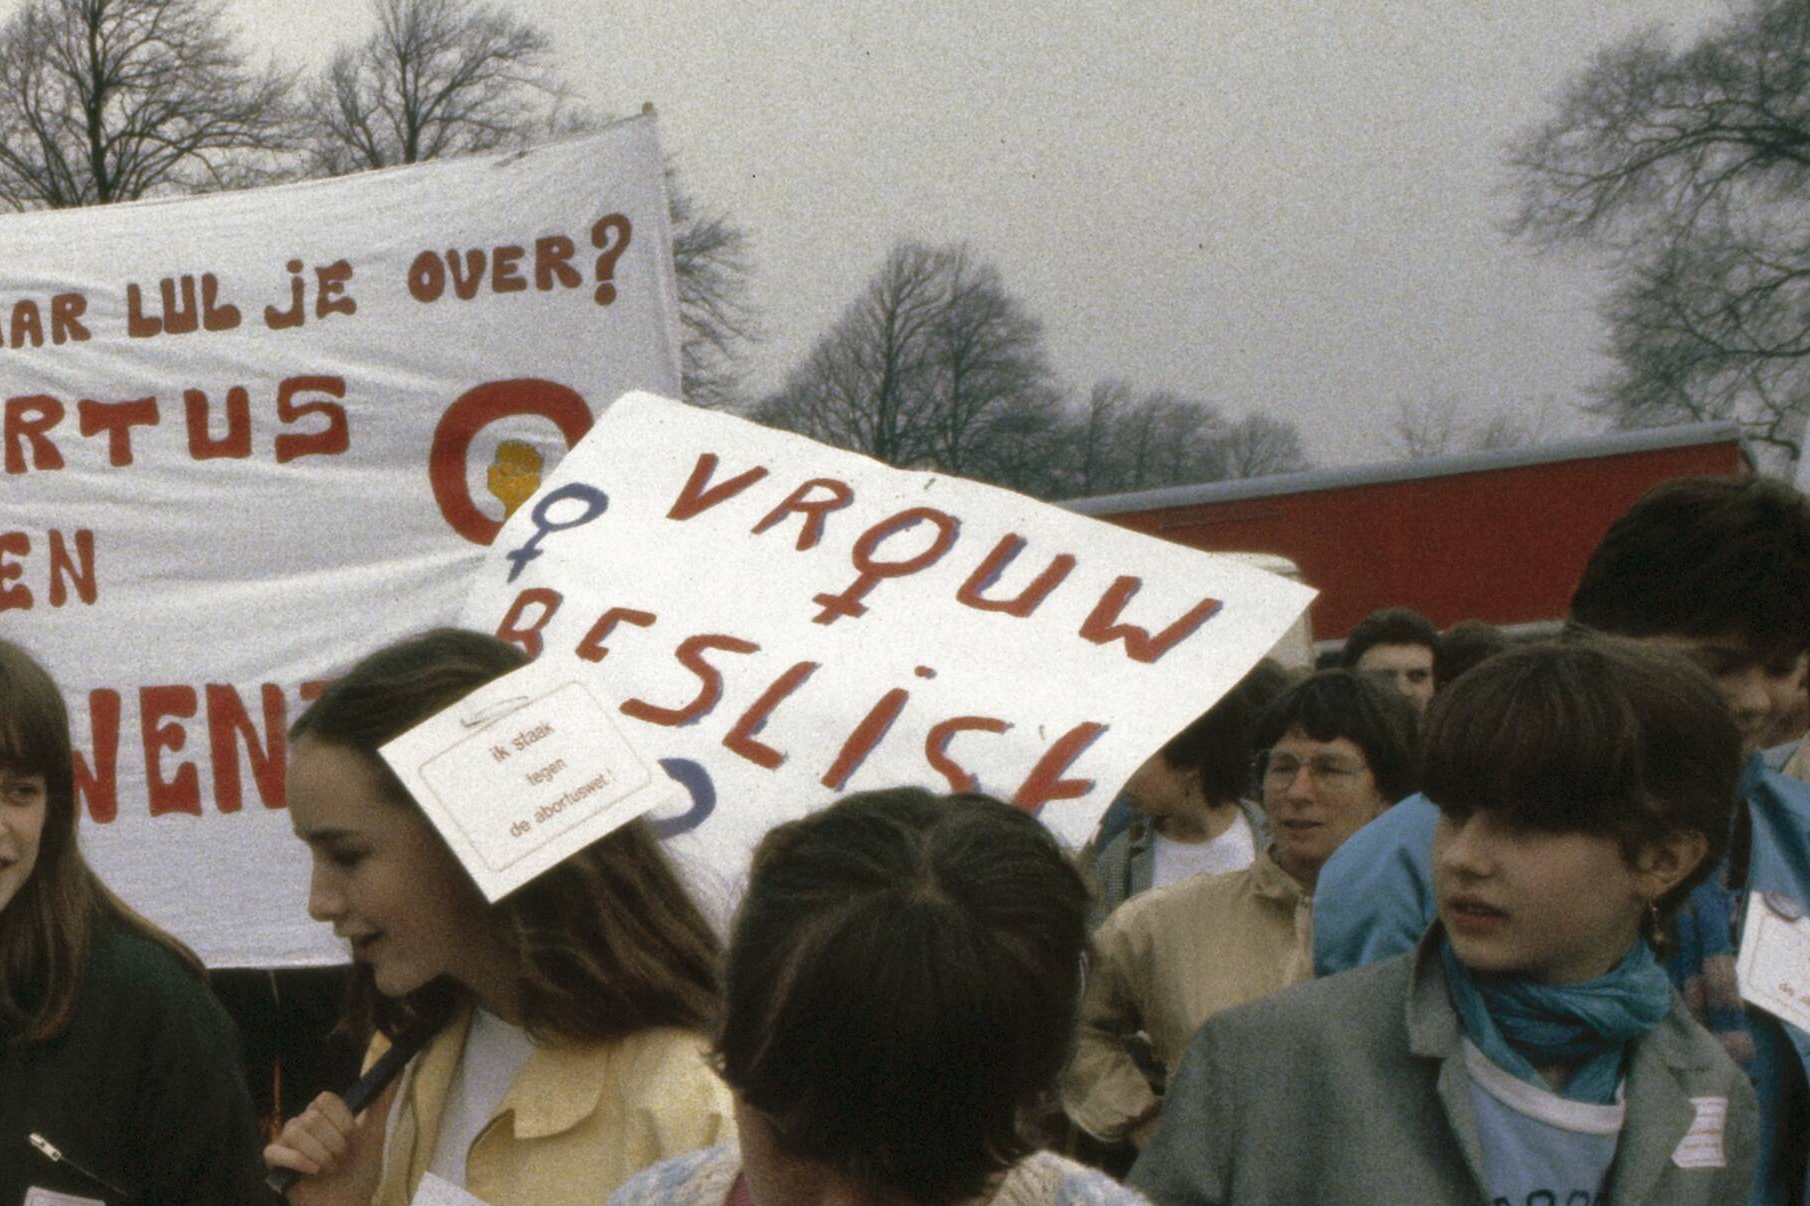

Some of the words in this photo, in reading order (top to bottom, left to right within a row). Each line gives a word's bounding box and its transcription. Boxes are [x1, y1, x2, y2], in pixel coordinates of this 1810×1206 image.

[125, 272, 242, 340] LUL
[405, 212, 634, 307] OVER?
[666, 450, 1224, 664] VROUW
[511, 722, 555, 752] staak
[526, 758, 567, 786] tegen
[509, 819, 531, 838] de
